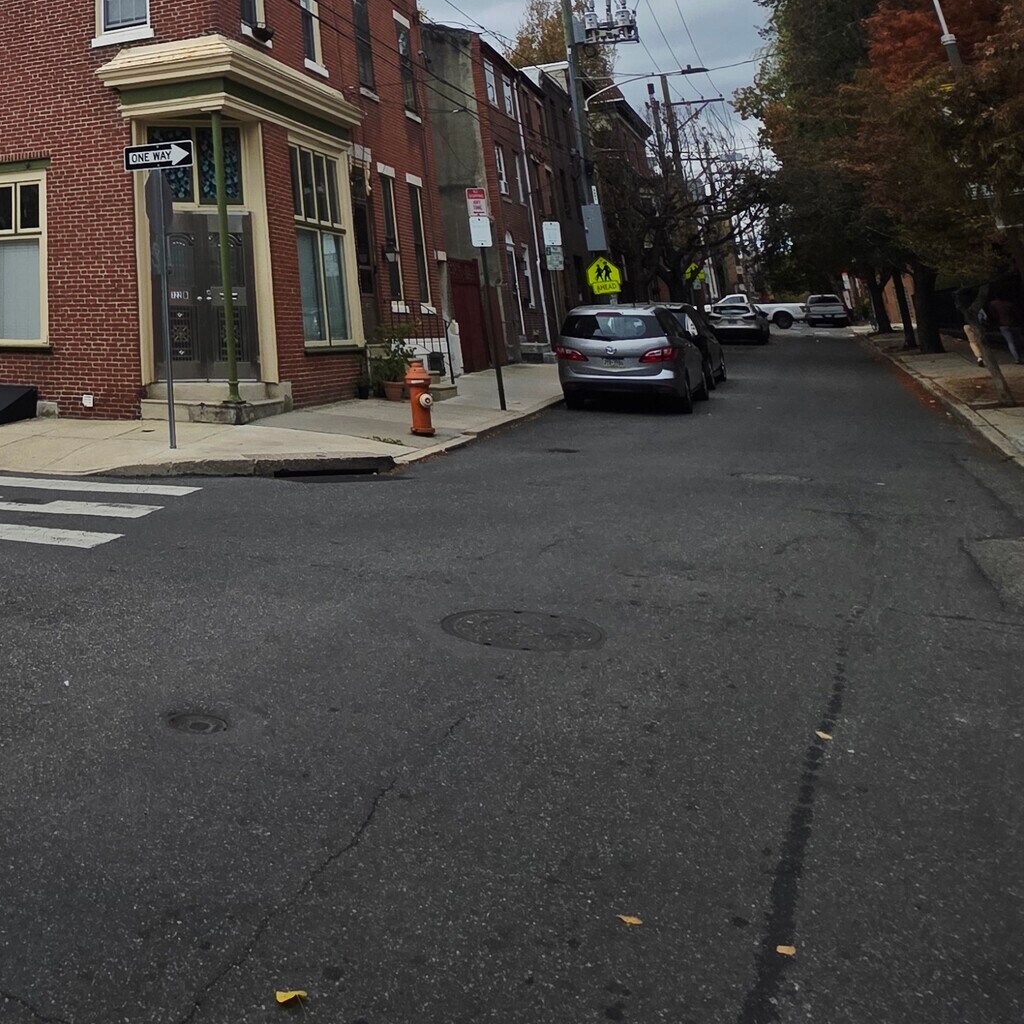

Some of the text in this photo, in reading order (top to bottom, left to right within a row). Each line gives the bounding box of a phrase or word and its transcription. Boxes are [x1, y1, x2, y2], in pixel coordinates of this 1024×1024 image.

[131, 150, 172, 163] ONE WAY
[596, 282, 617, 291] AHEAD
